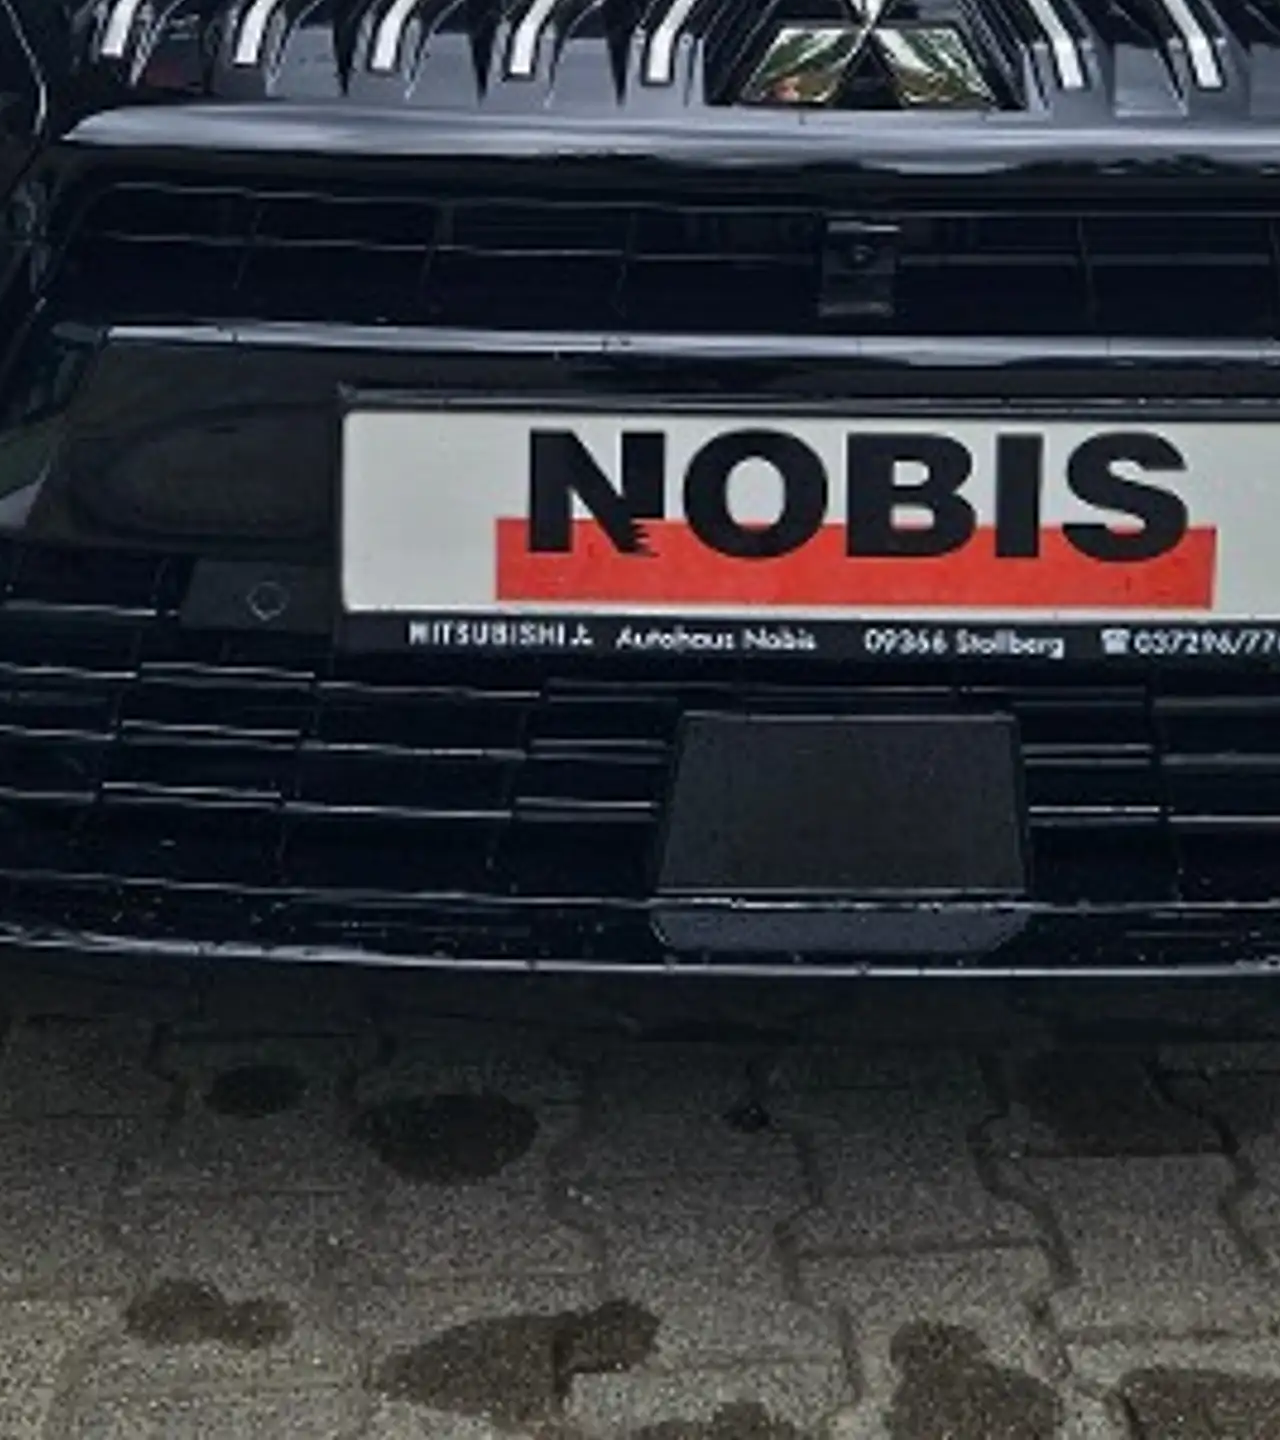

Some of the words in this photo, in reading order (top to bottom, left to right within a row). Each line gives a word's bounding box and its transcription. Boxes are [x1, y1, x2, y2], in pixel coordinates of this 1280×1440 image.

[528, 428, 1189, 562] NOBIS
[408, 620, 565, 647] MITSUBISHI
[615, 624, 734, 654] Autohaus
[742, 626, 816, 651] Nobis
[956, 628, 1064, 659] Stollberg
